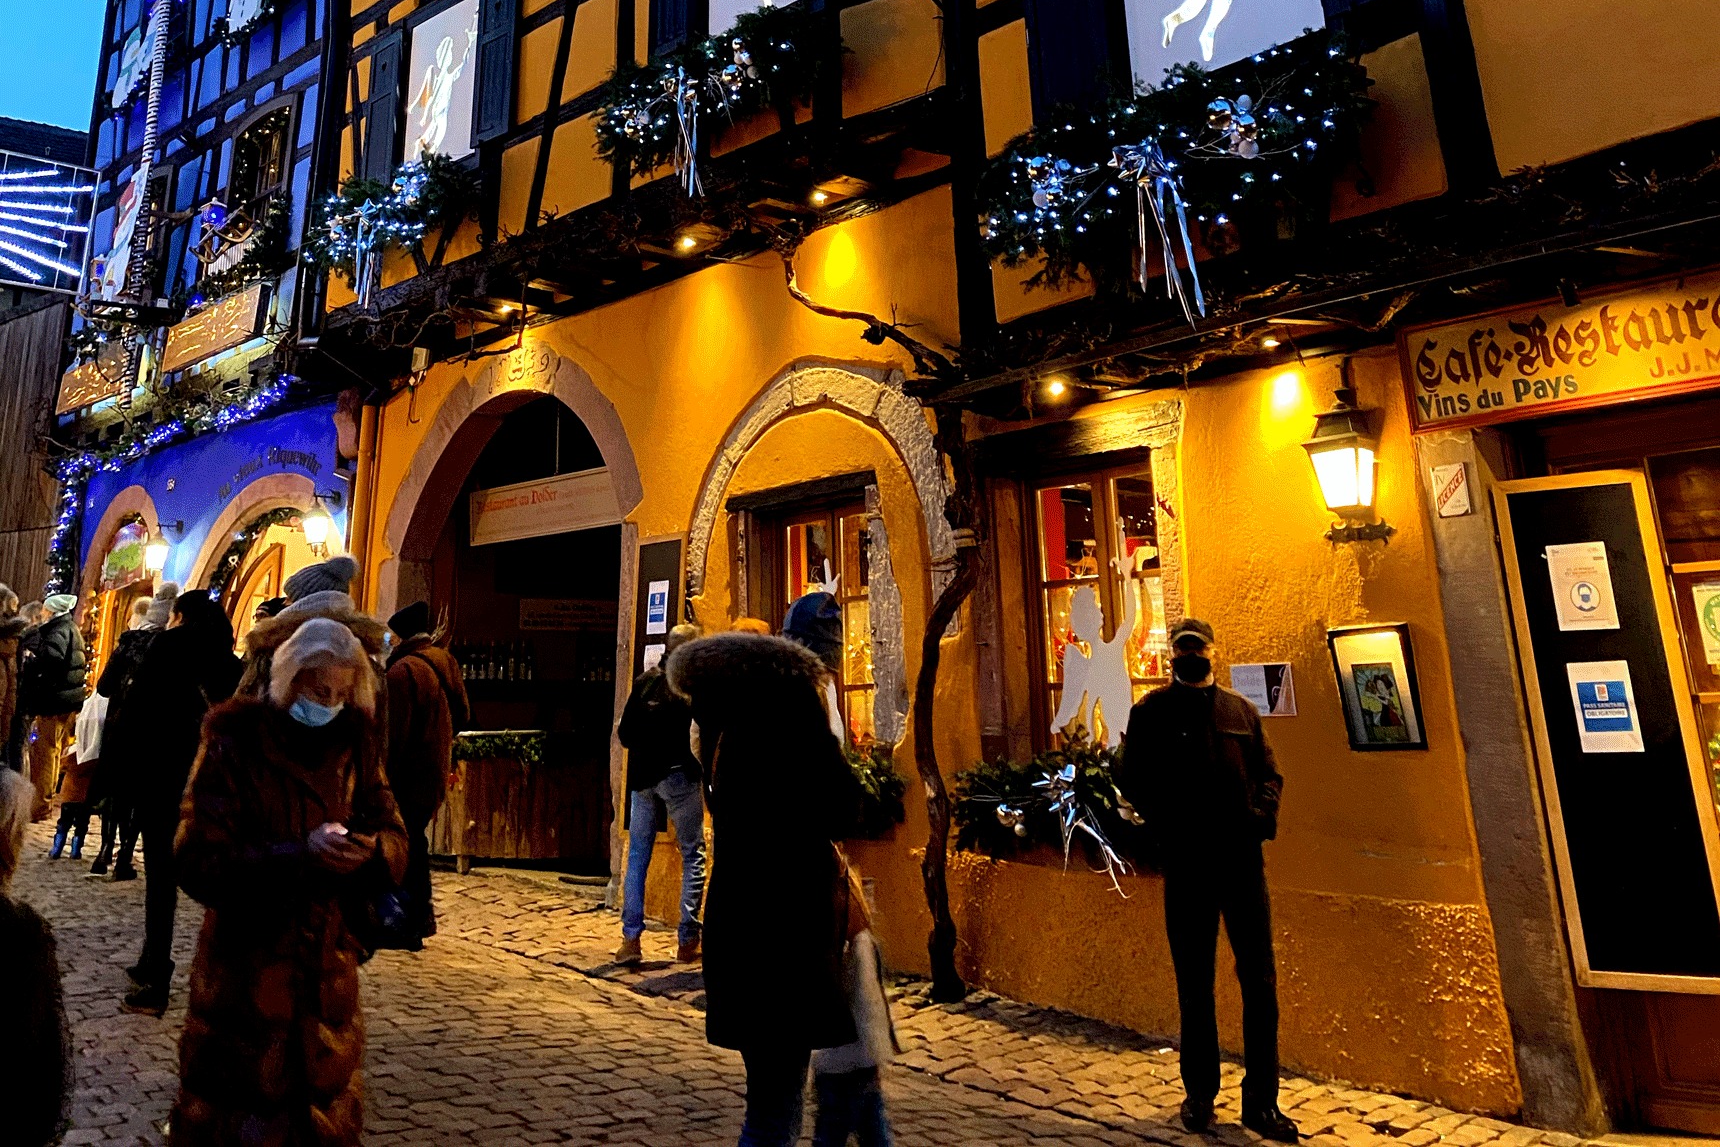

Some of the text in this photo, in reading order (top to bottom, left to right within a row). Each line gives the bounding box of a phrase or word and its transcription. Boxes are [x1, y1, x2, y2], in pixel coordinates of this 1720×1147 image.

[1417, 374, 1578, 420] Vins du Pays
[1438, 468, 1464, 510] LICENCE
